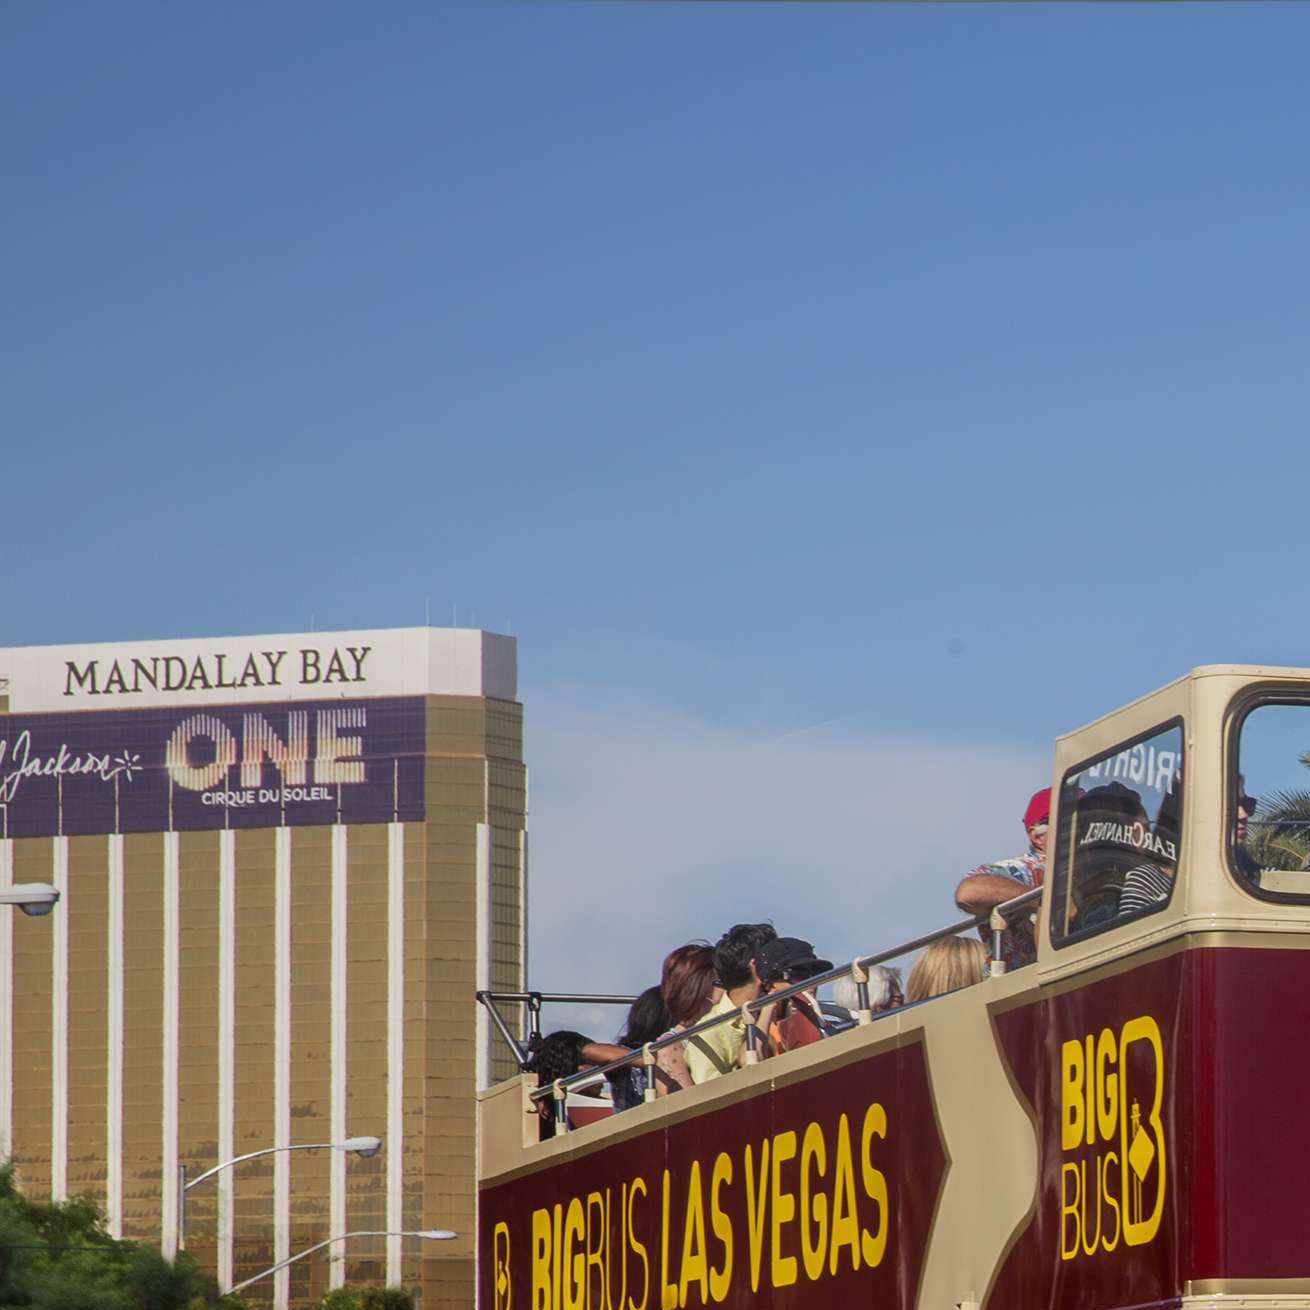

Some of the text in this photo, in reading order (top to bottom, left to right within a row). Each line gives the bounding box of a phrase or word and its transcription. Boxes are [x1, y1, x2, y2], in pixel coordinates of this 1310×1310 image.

[63, 646, 372, 696] MANDALAY BAY
[1, 729, 126, 803] Jackson
[166, 707, 367, 791] ONE
[201, 787, 333, 808] CIRQUE DU SOLEIL
[1061, 1025, 1118, 1152] BIG
[744, 1102, 888, 1294] VEGAS
[1061, 1150, 1120, 1261] BUS
